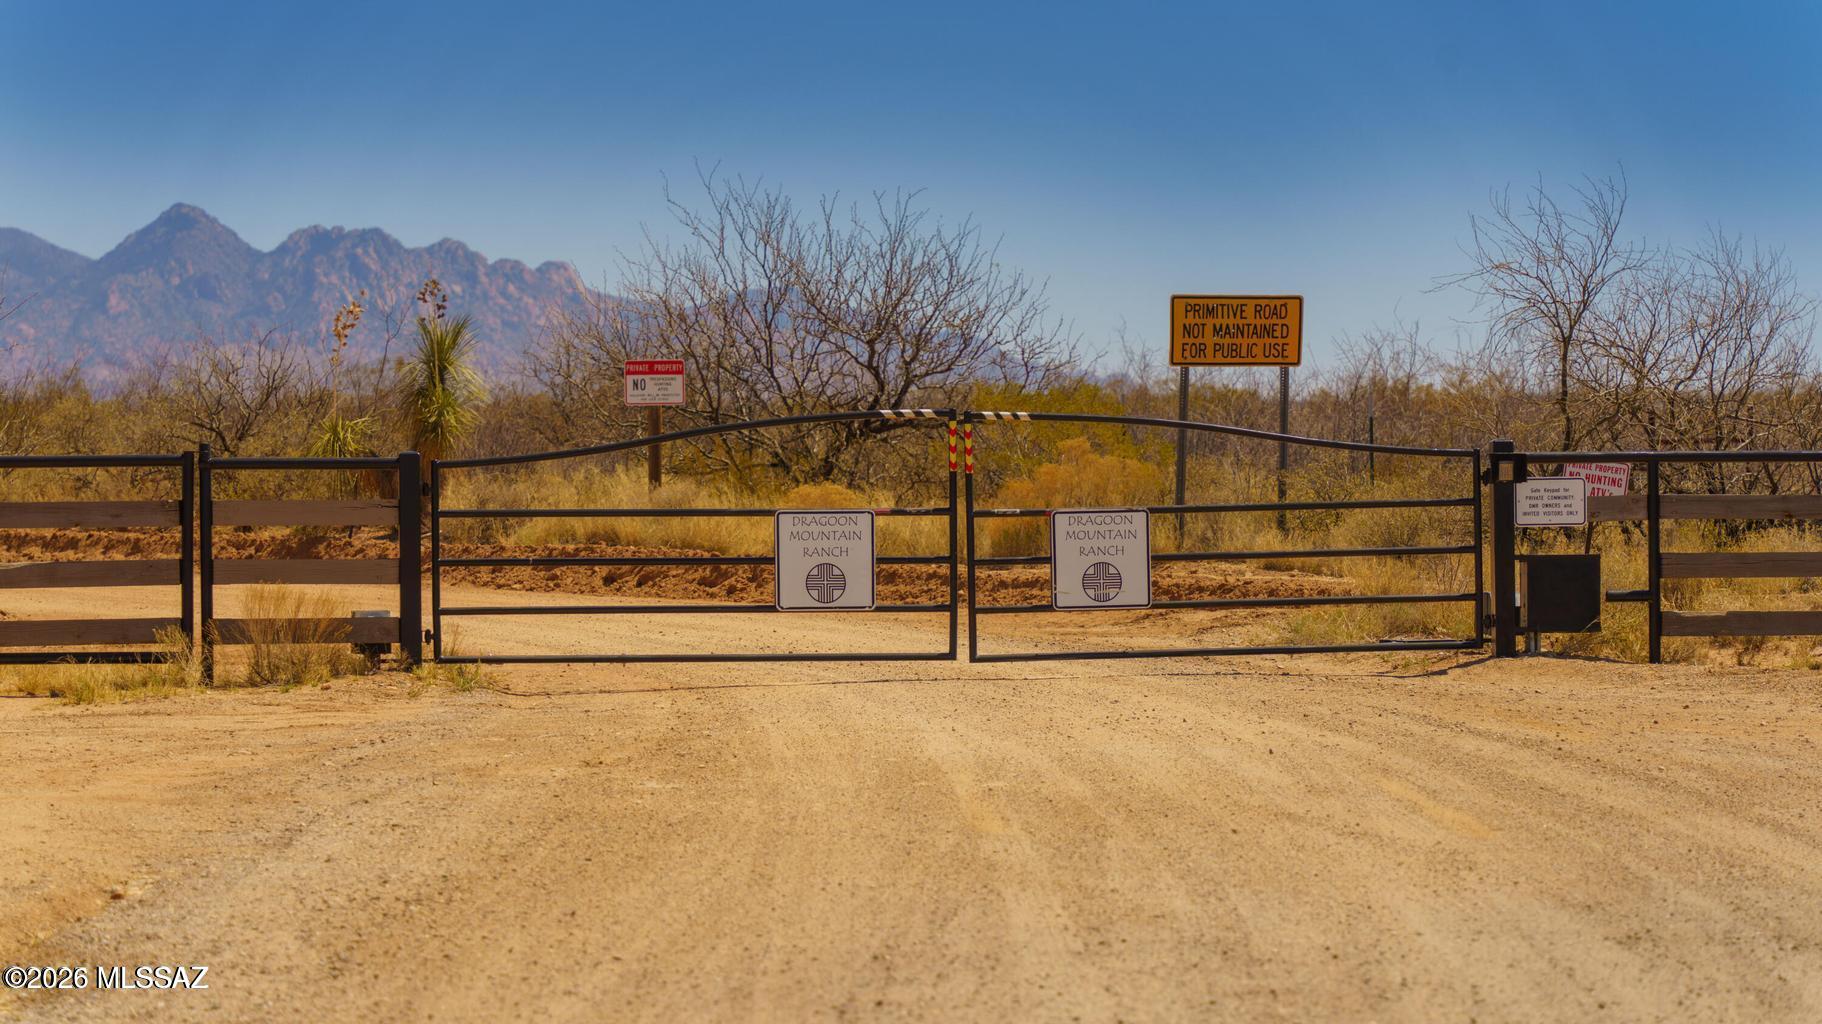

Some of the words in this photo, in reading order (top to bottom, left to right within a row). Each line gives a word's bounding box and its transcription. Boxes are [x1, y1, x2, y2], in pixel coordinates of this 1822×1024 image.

[1184, 303, 1247, 320] PRIMITIVE
[1254, 303, 1288, 320] ROAD
[1182, 323, 1207, 339] NOT
[1213, 323, 1289, 339] MAINTAINED
[1181, 342, 1207, 359] FOR
[1213, 342, 1258, 359] PUBLIC
[1263, 342, 1289, 359] USE
[626, 363, 649, 372] PRIVATE
[654, 363, 683, 372] PROPERTY
[632, 378, 647, 391] NO
[1567, 462, 1592, 471] PRIVATE
[1594, 463, 1626, 475] PROPERTY
[1585, 472, 1623, 488] HUNTING
[792, 516, 858, 526] DRAGOON
[1068, 515, 1133, 526] DRAGOON
[789, 530, 862, 541] MOUNTAIN
[1065, 530, 1137, 540] MOUNTAIN
[803, 546, 849, 558] RANCH
[1079, 546, 1125, 556] RANCH
